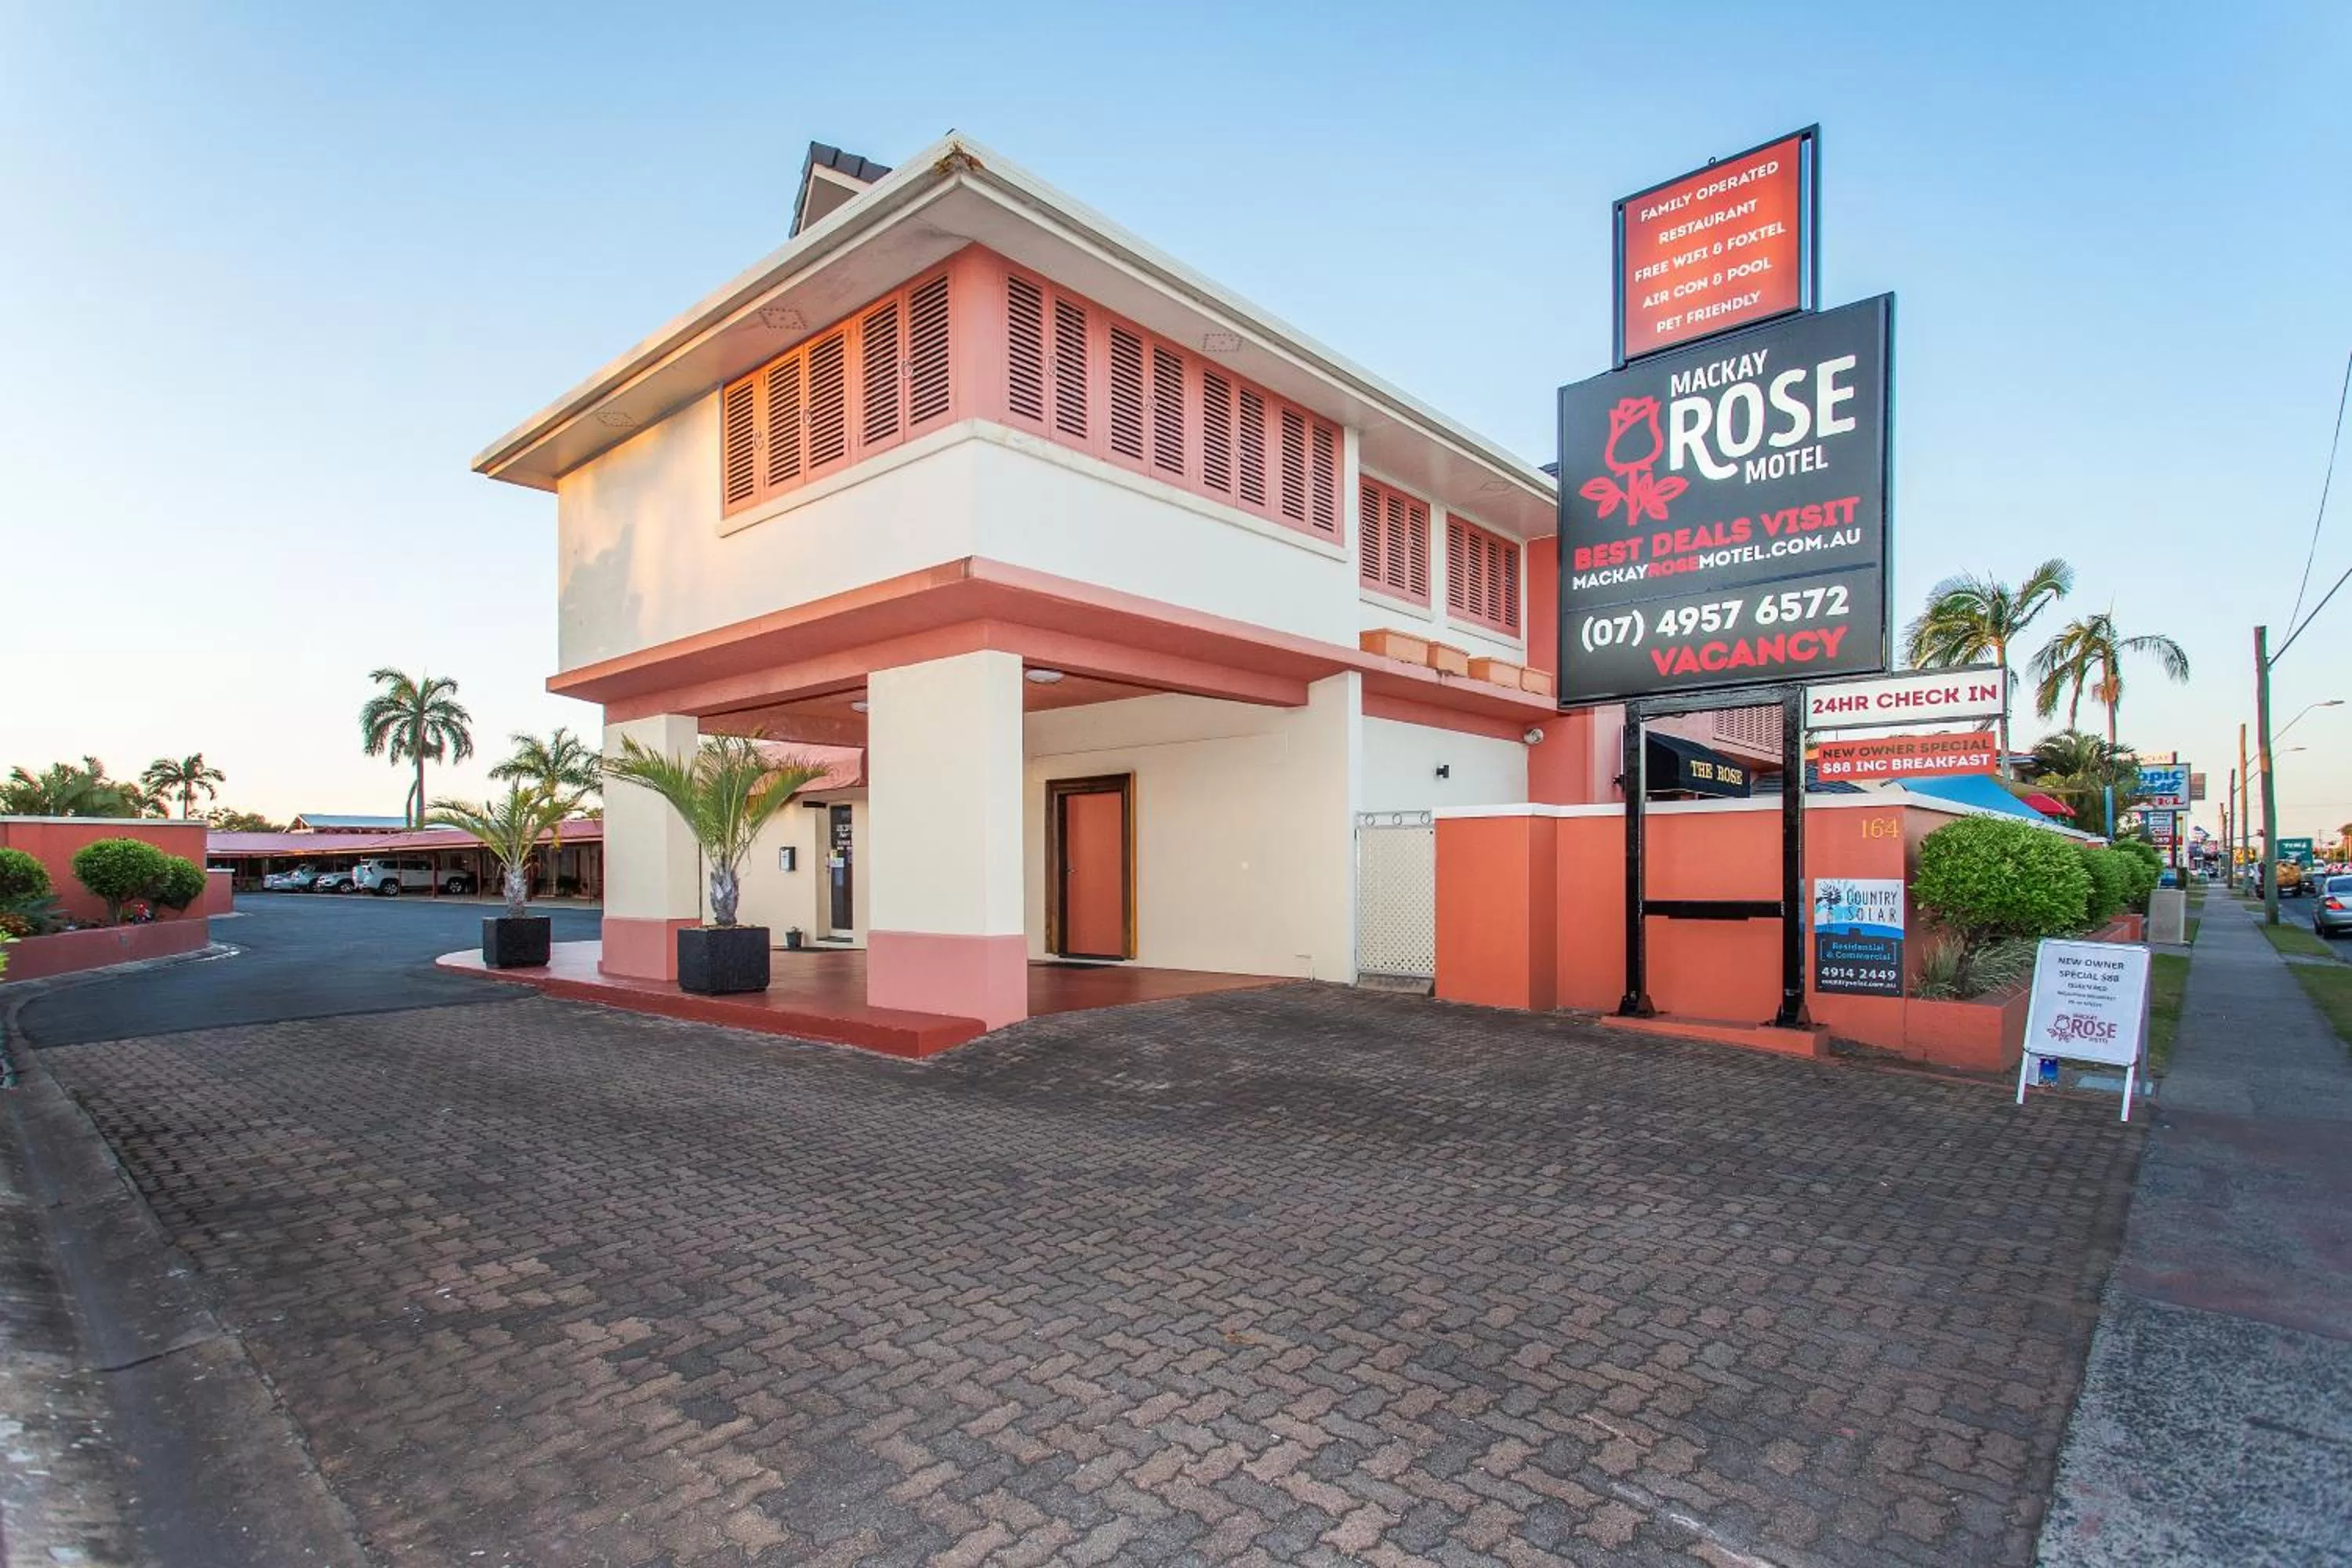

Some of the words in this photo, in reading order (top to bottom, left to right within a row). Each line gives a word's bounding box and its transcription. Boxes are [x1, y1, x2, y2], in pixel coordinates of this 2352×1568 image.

[1641, 193, 1692, 222] FAMILY
[1696, 161, 1779, 201] OPERATED
[1659, 198, 1758, 245] RESTAURANT
[1635, 260, 1669, 283] FREE
[1672, 247, 1708, 270] WIFI
[1712, 241, 1723, 256] &
[1727, 221, 1785, 250] FOXTEL
[1642, 289, 1669, 309] AIR
[1674, 276, 1708, 299] CON
[1712, 272, 1723, 286] &
[1727, 257, 1773, 281] POOL
[1656, 314, 1683, 334] PET
[1686, 290, 1761, 325] FRIENDLY
[1671, 349, 1768, 397] MACKAY
[1669, 354, 1857, 481] ROSE
[1745, 445, 1828, 484] MOTEL
[1574, 537, 1643, 571] BEST
[1652, 517, 1751, 557] DEALS
[1760, 496, 1860, 538] VISIT
[1573, 528, 1860, 590] MACKAYROSEMOTEL.COM.AU
[1581, 609, 1644, 653] (07)
[1656, 600, 1743, 637] 4957
[1755, 585, 1849, 624] 6572
[1650, 626, 1847, 677] VACANCY
[1812, 695, 1869, 714] 24HR
[1876, 687, 1960, 709] CHECK
[1968, 684, 1997, 702] IN
[1823, 746, 1856, 760] NEW
[1859, 743, 1915, 757] OWNER
[1919, 739, 1991, 753] SPECIAL
[1856, 760, 1887, 772] INC
[1892, 753, 1991, 771] BREAKFAST
[1690, 760, 1713, 779] THE
[1716, 764, 1743, 785] ROSE
[1861, 818, 1900, 838] 164
[1846, 887, 1898, 906] COUNTRY
[1848, 906, 1896, 923] SOLAR
[1832, 942, 1885, 951] Residential
[1835, 951, 1890, 960] Commercial
[1821, 967, 1854, 978] 4914
[1859, 968, 1896, 981] 2449
[2058, 956, 2082, 966] NEW
[2085, 959, 2125, 970] OWNER
[2059, 970, 2098, 981] SPECIAL
[2071, 1018, 2118, 1039] ROSE
